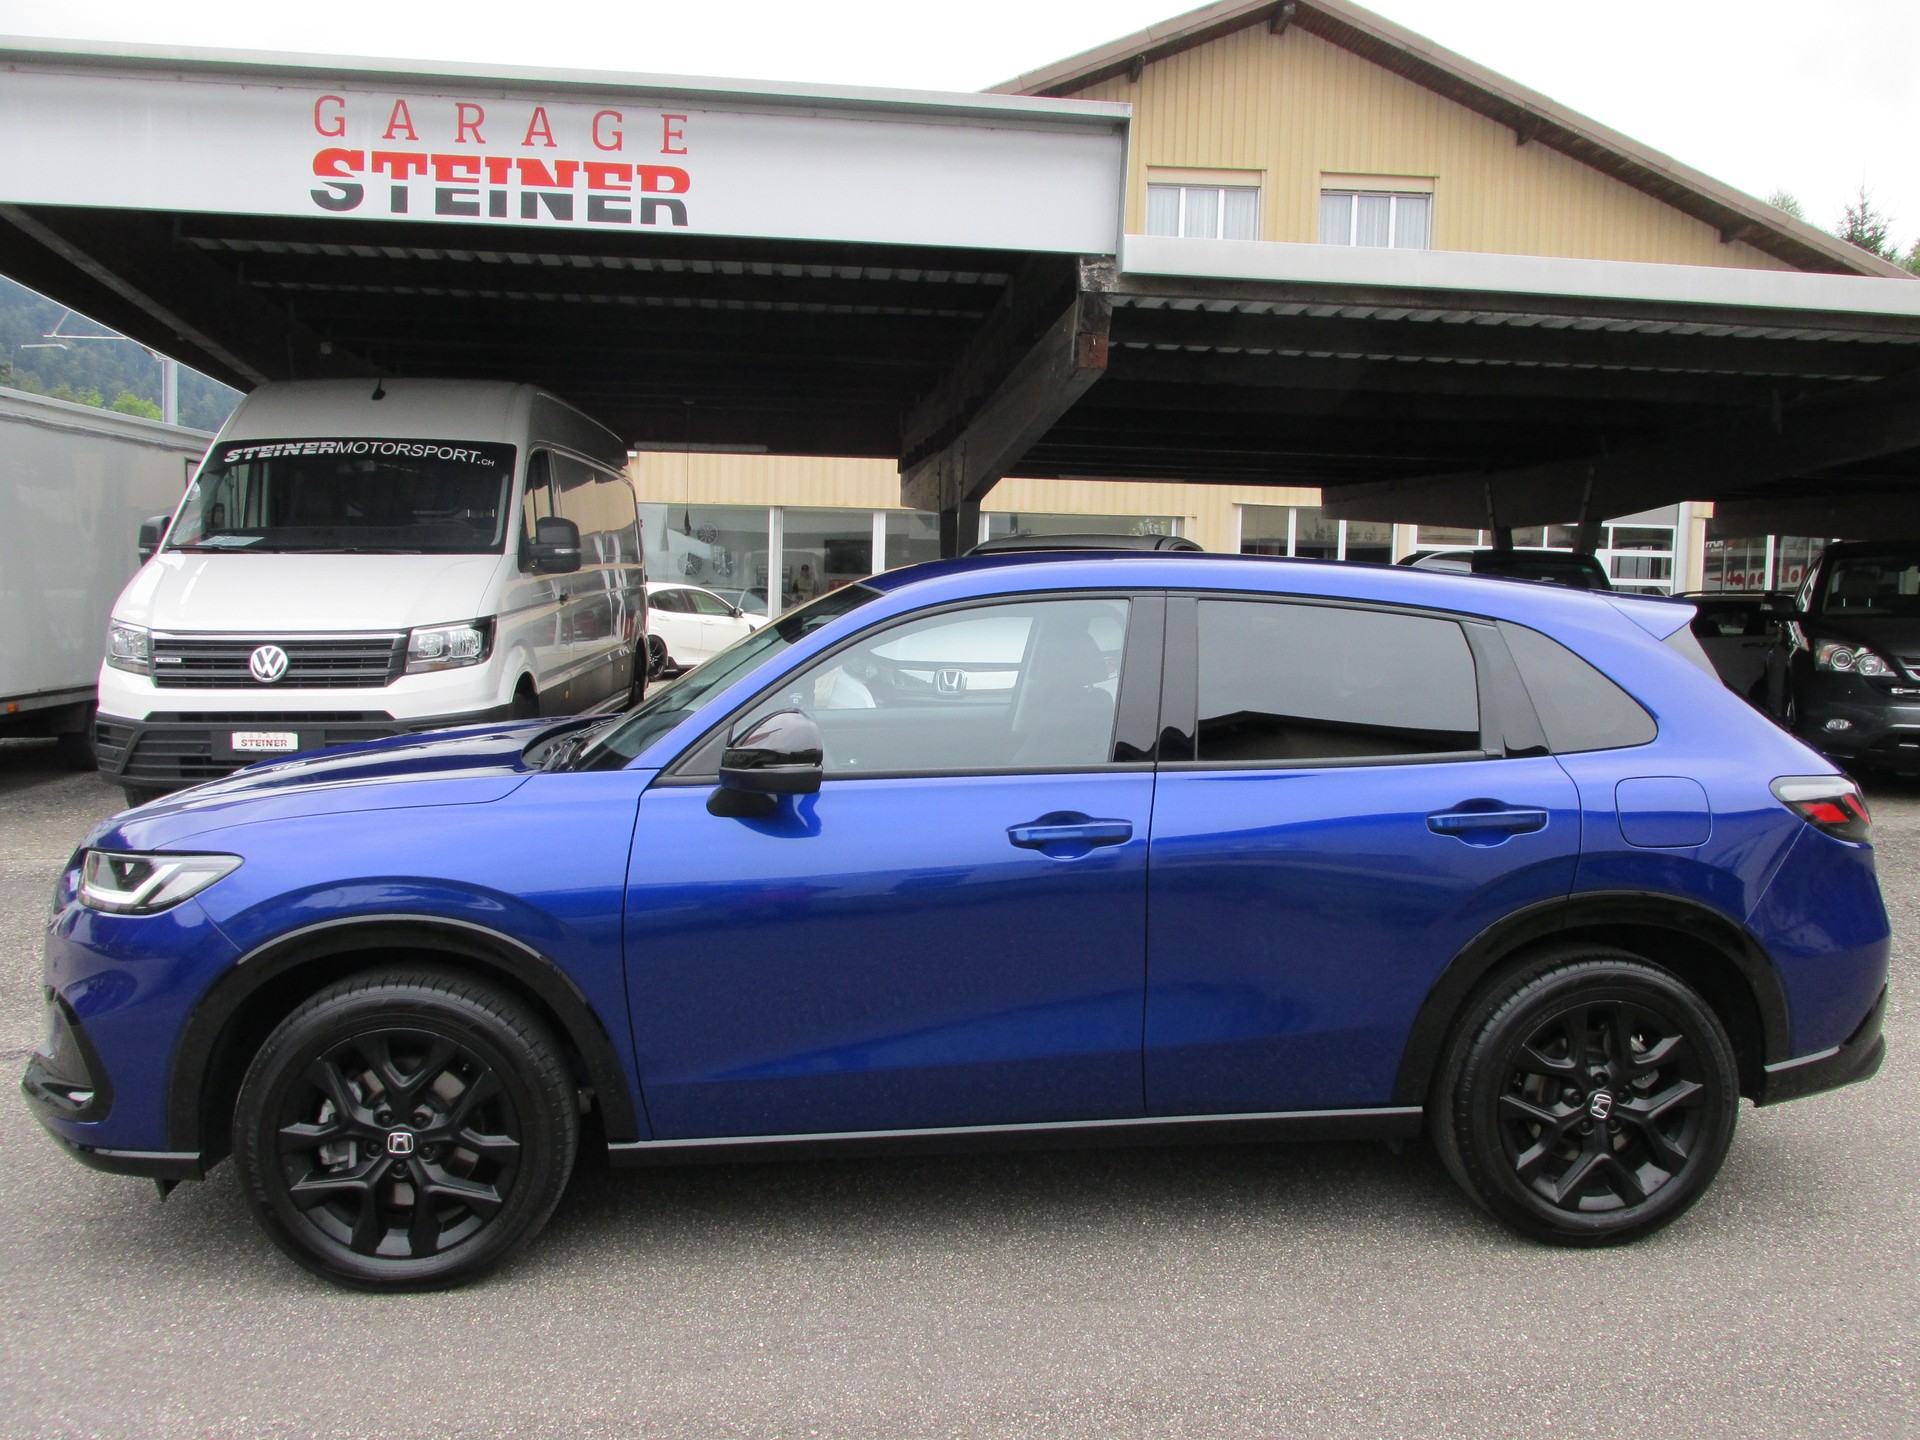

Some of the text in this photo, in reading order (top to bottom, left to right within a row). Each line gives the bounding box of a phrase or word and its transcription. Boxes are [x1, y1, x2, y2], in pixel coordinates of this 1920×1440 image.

[313, 94, 689, 155] GARAGE
[310, 146, 691, 227] STEINER
[240, 739, 288, 747] STEINER
